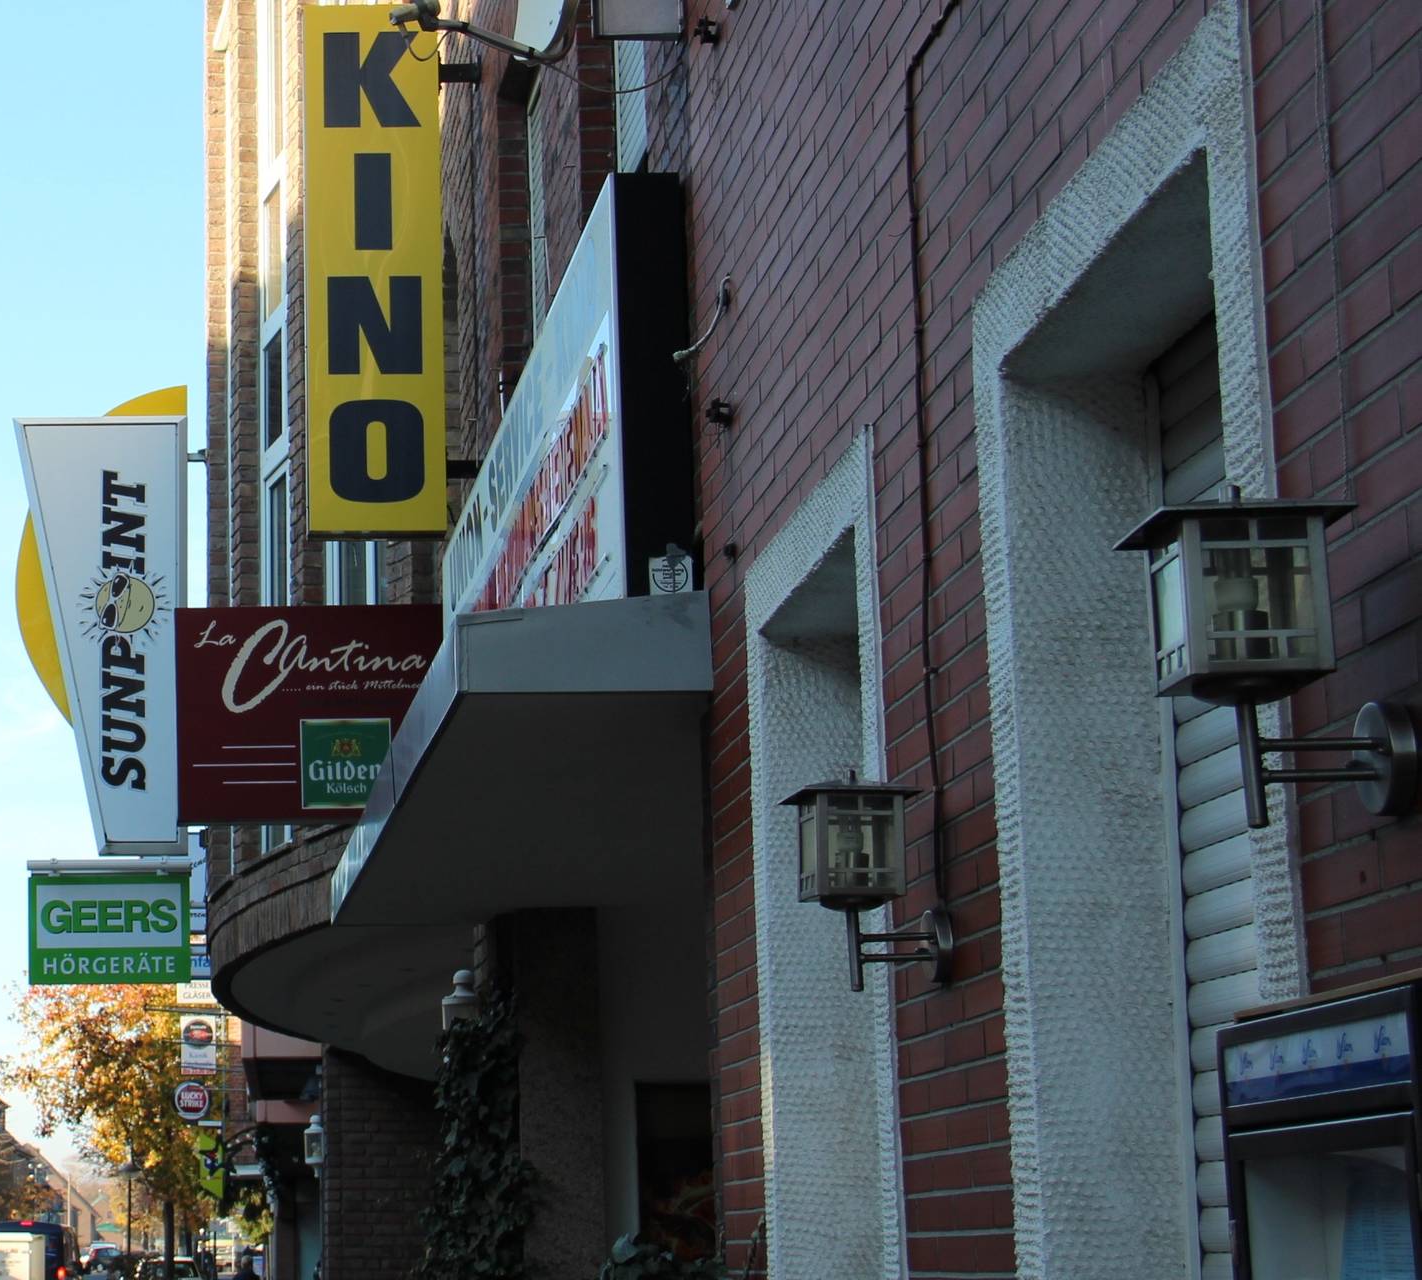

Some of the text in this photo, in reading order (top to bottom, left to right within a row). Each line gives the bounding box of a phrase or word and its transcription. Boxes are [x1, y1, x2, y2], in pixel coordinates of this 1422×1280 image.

[324, 32, 425, 503] KINO
[194, 619, 426, 713] La Cantina
[309, 760, 382, 780] Gilden
[326, 781, 367, 793] Kölsch
[41, 899, 178, 934] GEERS
[43, 952, 175, 974] HÖRGERÄTE
[180, 1091, 203, 1099] LUCKY
